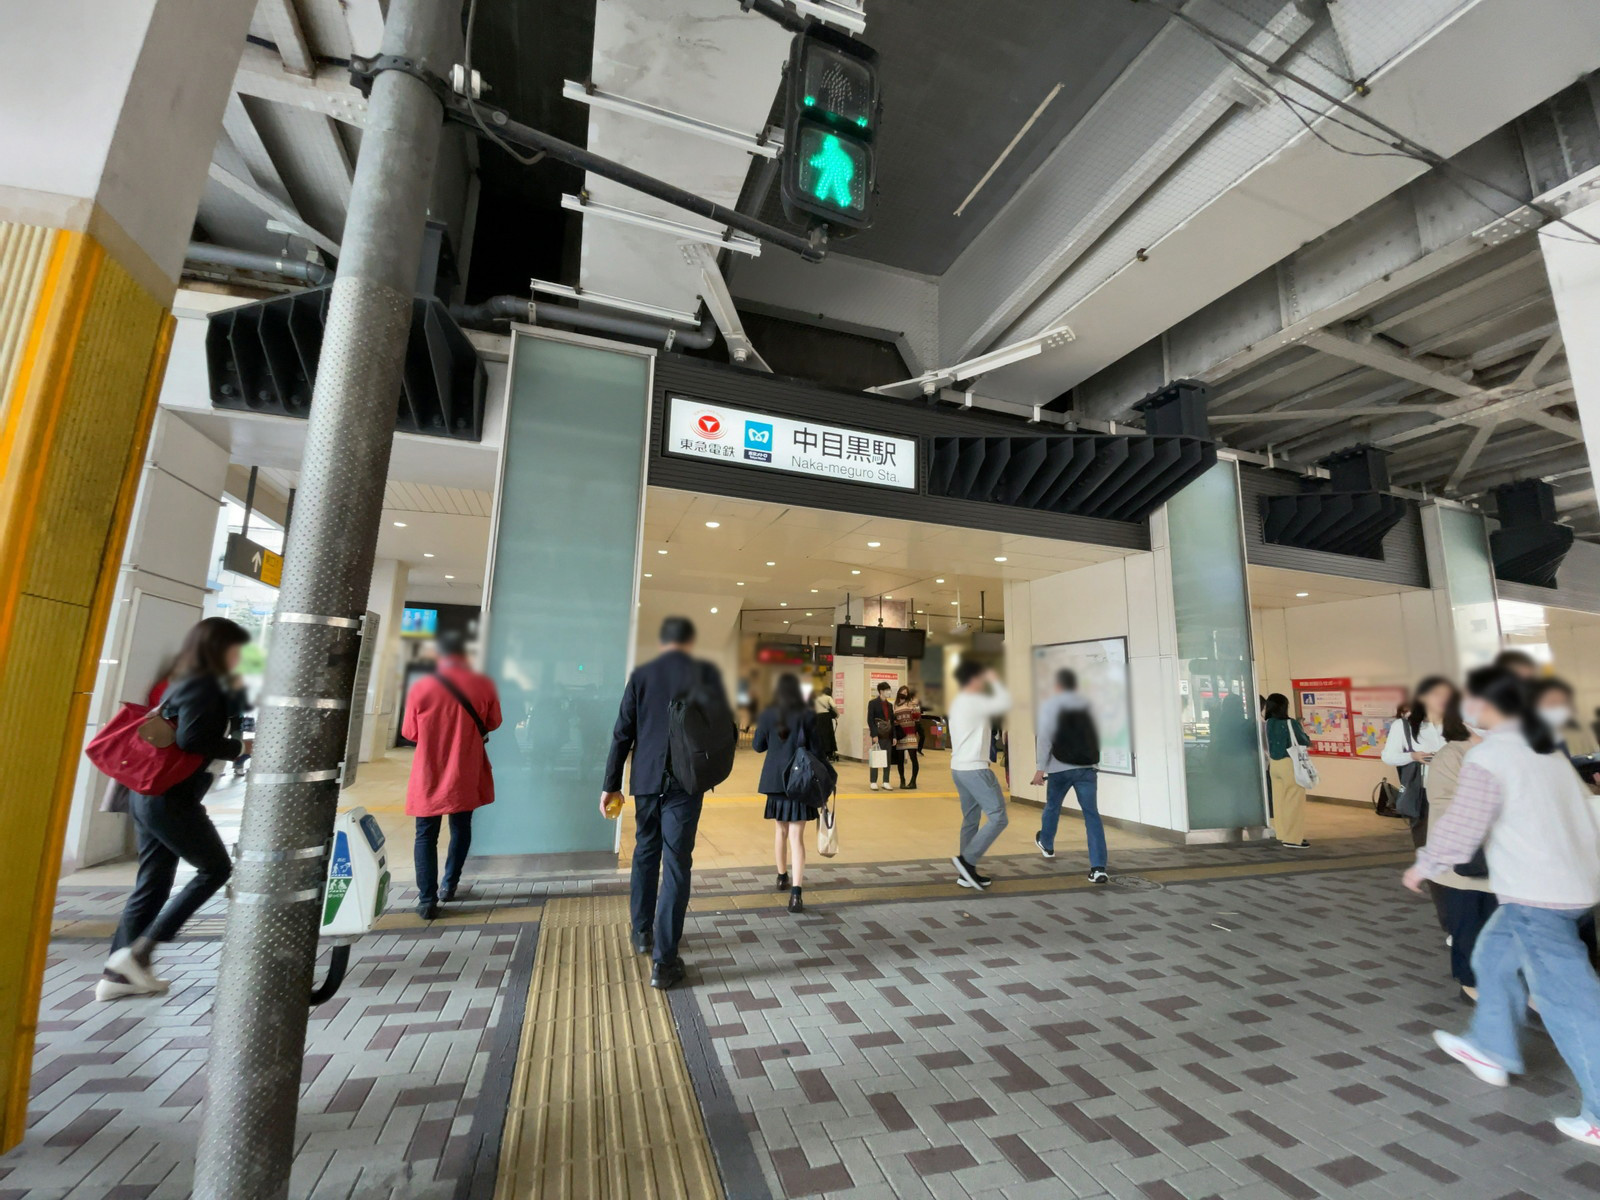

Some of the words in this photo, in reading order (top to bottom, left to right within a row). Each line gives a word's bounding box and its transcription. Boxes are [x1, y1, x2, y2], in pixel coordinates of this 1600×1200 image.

[680, 438, 735, 458] 東急電鉄
[793, 427, 896, 467] 中目黒駅
[791, 455, 874, 478] Naka-meguro
[877, 468, 900, 483] Sta.
